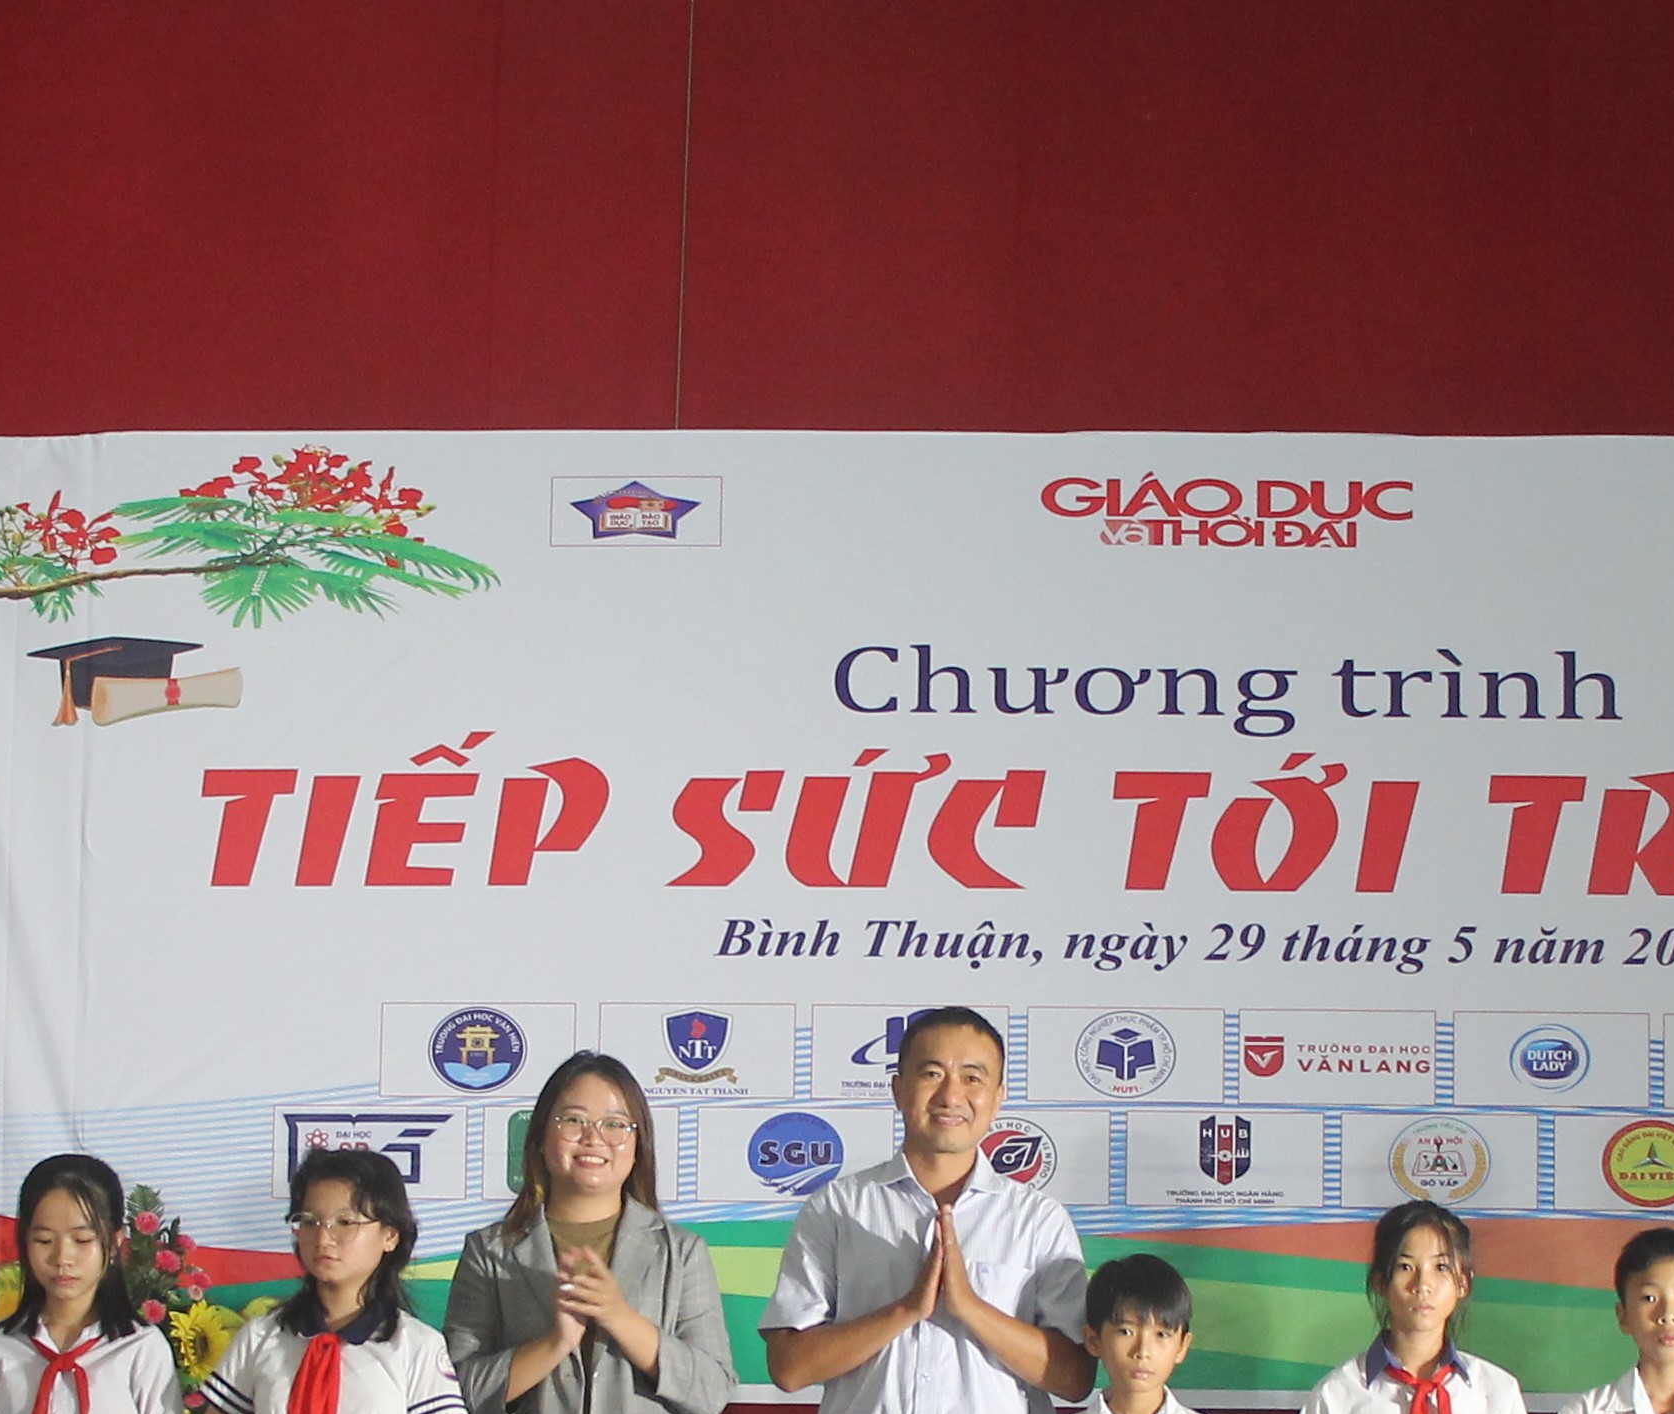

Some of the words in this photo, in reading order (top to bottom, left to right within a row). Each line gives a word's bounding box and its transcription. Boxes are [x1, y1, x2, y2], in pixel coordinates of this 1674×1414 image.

[1041, 471, 1242, 518] GIÁO
[833, 644, 1299, 737] Chương
[1332, 650, 1623, 720] trình
[200, 731, 611, 887] TIẾP
[665, 749, 1043, 890] SỨC
[1113, 753, 1420, 894] TỚI
[715, 918, 841, 957] Bình
[863, 919, 1044, 970] Thuận,
[1063, 921, 1188, 972] ngày
[1204, 922, 1266, 962] 29
[1281, 923, 1431, 974] tháng
[1447, 926, 1475, 964] 5
[1493, 926, 1605, 964] năm
[678, 1040, 717, 1059] NTT
[1297, 1043, 1362, 1053] TRƯỜNG
[1400, 1046, 1430, 1056] HỌC
[1527, 1050, 1572, 1061] DUTCH
[1532, 1061, 1567, 1072] LADY
[759, 1140, 832, 1166] SGU
